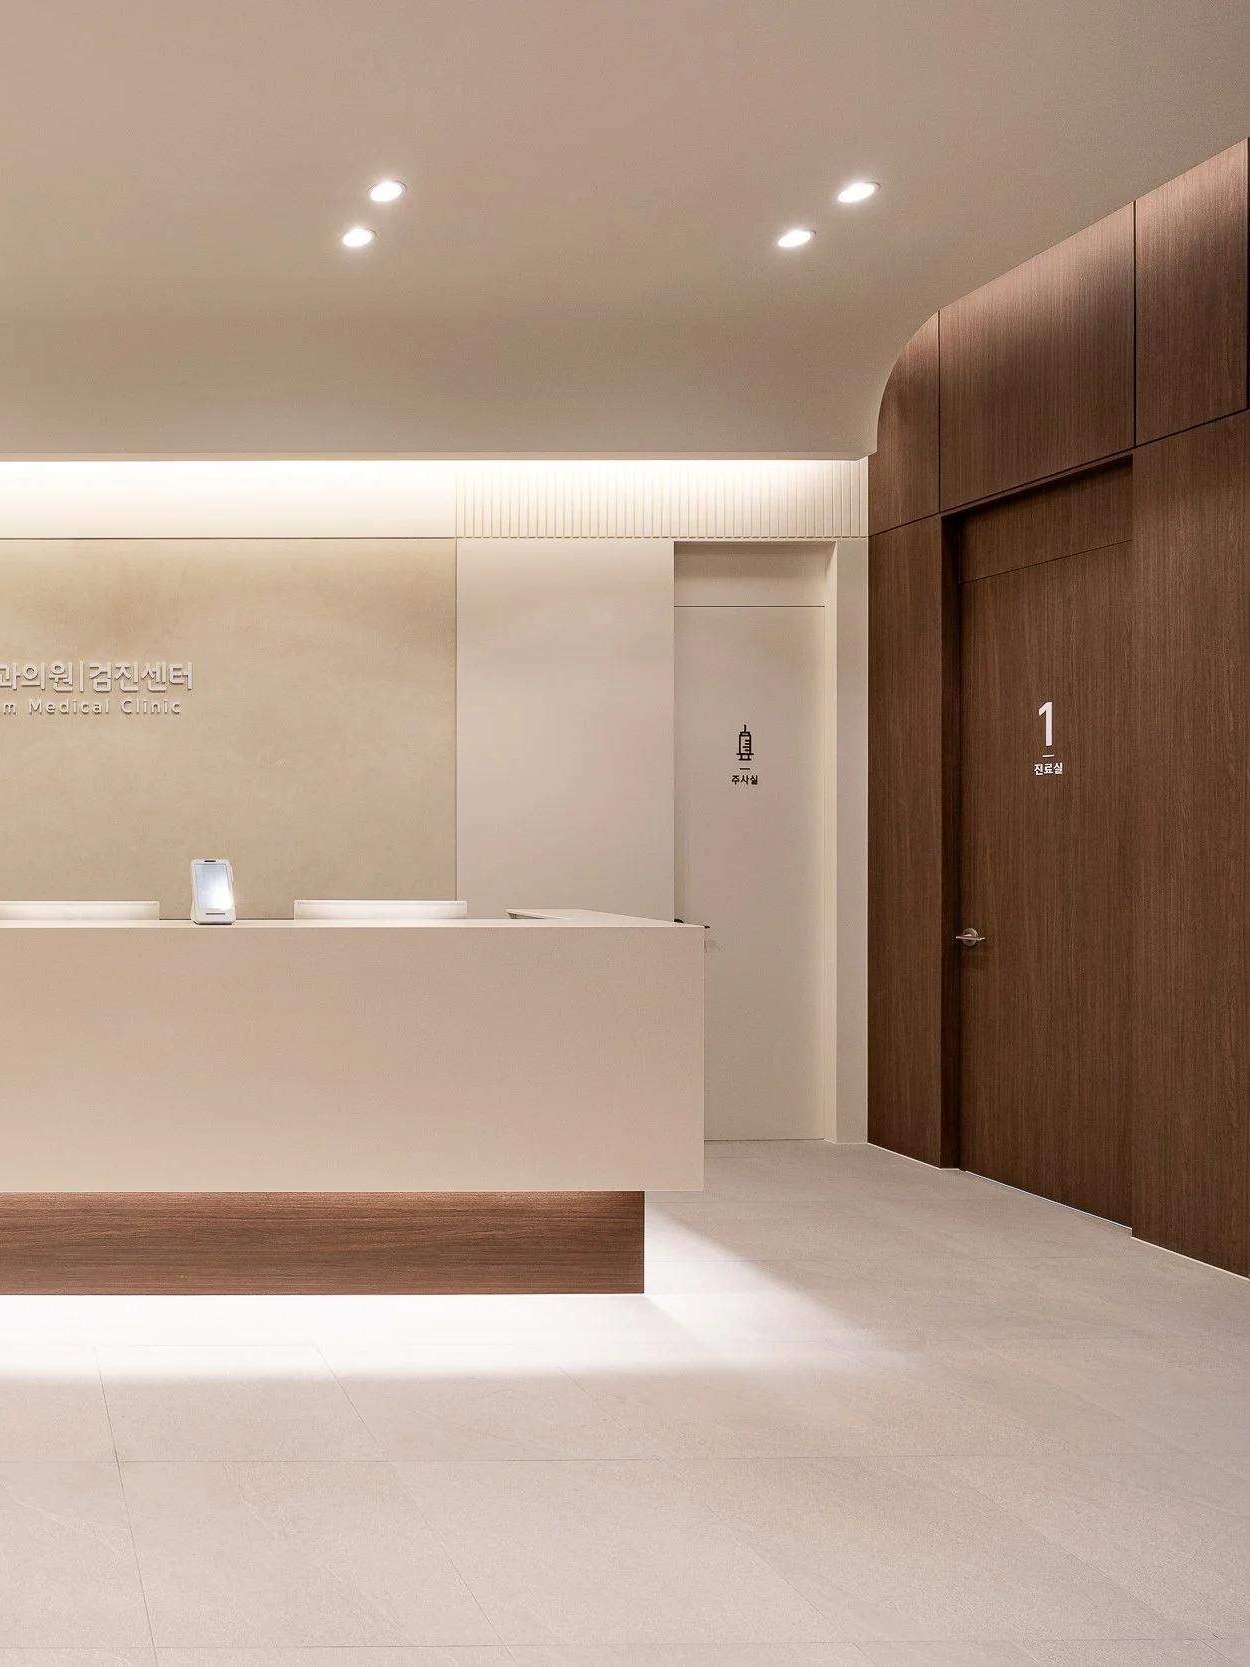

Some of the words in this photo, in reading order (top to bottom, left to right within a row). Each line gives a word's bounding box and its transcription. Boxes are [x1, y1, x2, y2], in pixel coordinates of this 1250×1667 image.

[28, 698, 111, 715] Medical
[121, 698, 182, 715] Clinic
[1038, 701, 1053, 747] 1
[1033, 762, 1063, 776] 진료실
[731, 774, 759, 785] 주사실
